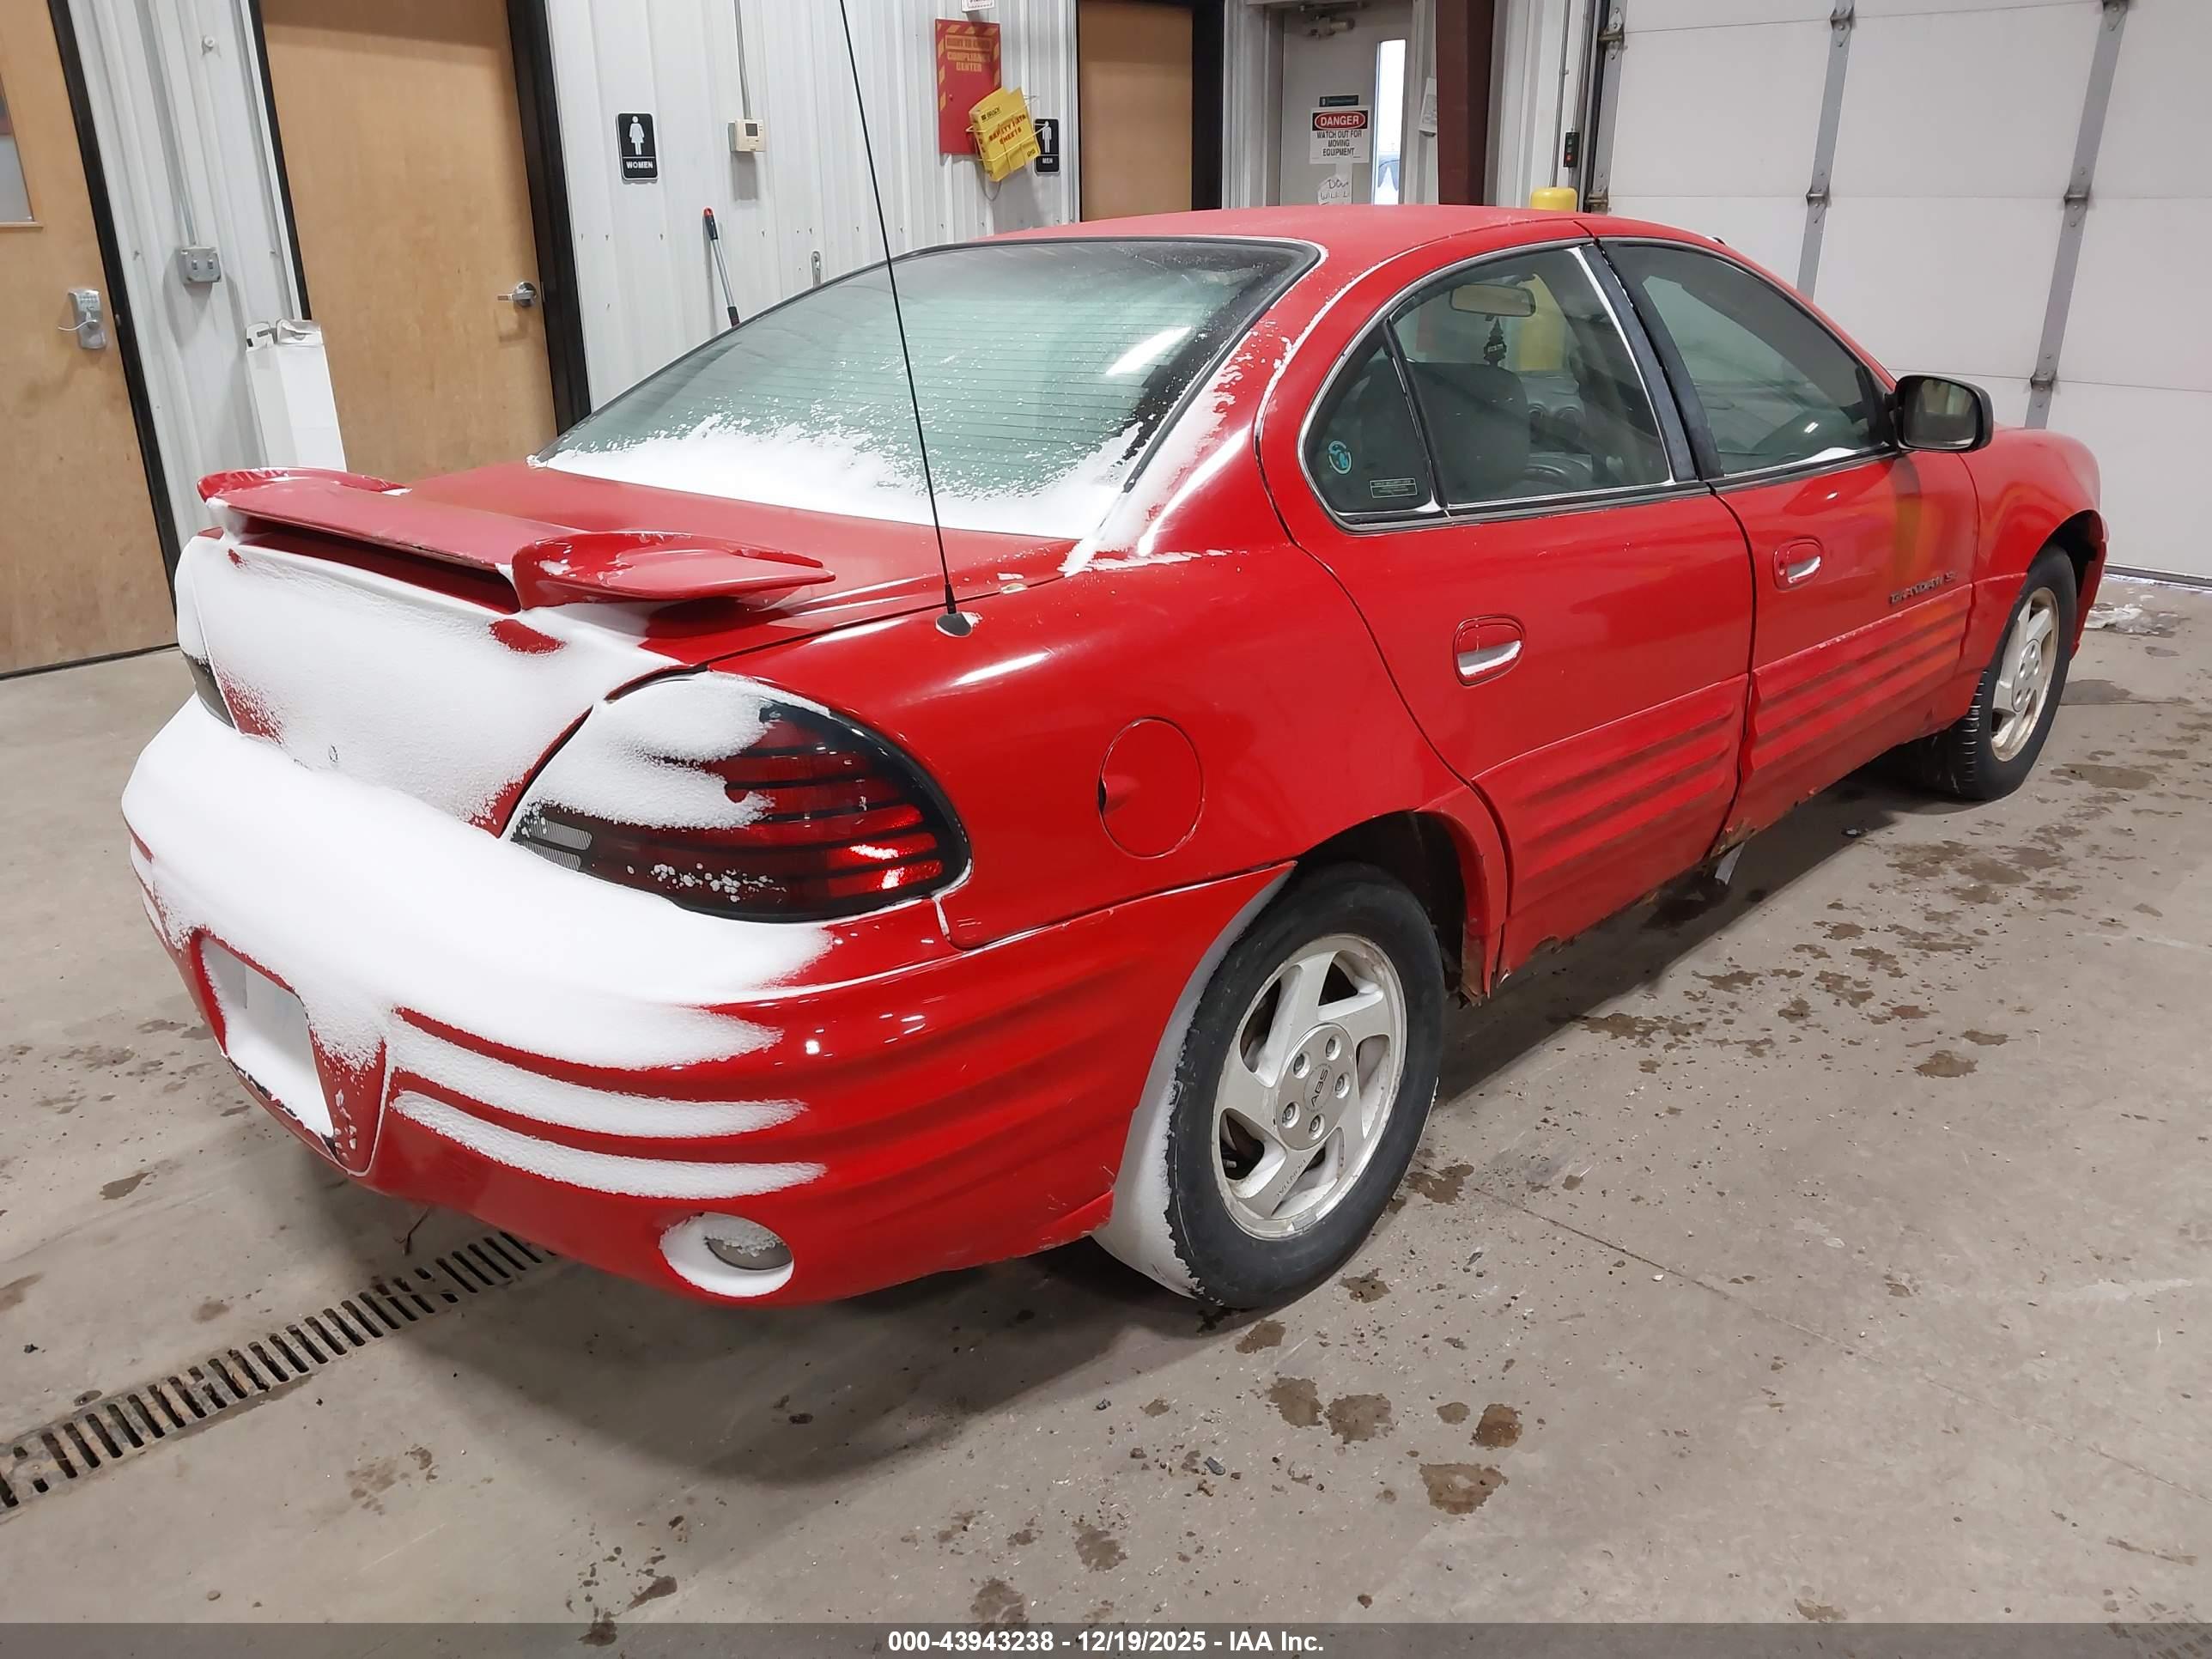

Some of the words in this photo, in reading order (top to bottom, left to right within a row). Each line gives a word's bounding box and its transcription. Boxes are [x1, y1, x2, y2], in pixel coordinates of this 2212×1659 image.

[1320, 115, 1359, 126] DANGER
[1316, 131, 1337, 139] WATCH
[1338, 130, 1349, 138] OUT
[1328, 139, 1350, 148] MOVING
[1322, 148, 1355, 156] EQUIPMENT
[626, 161, 653, 169] WOMEN
[1310, 1069, 1328, 1107] ABS
